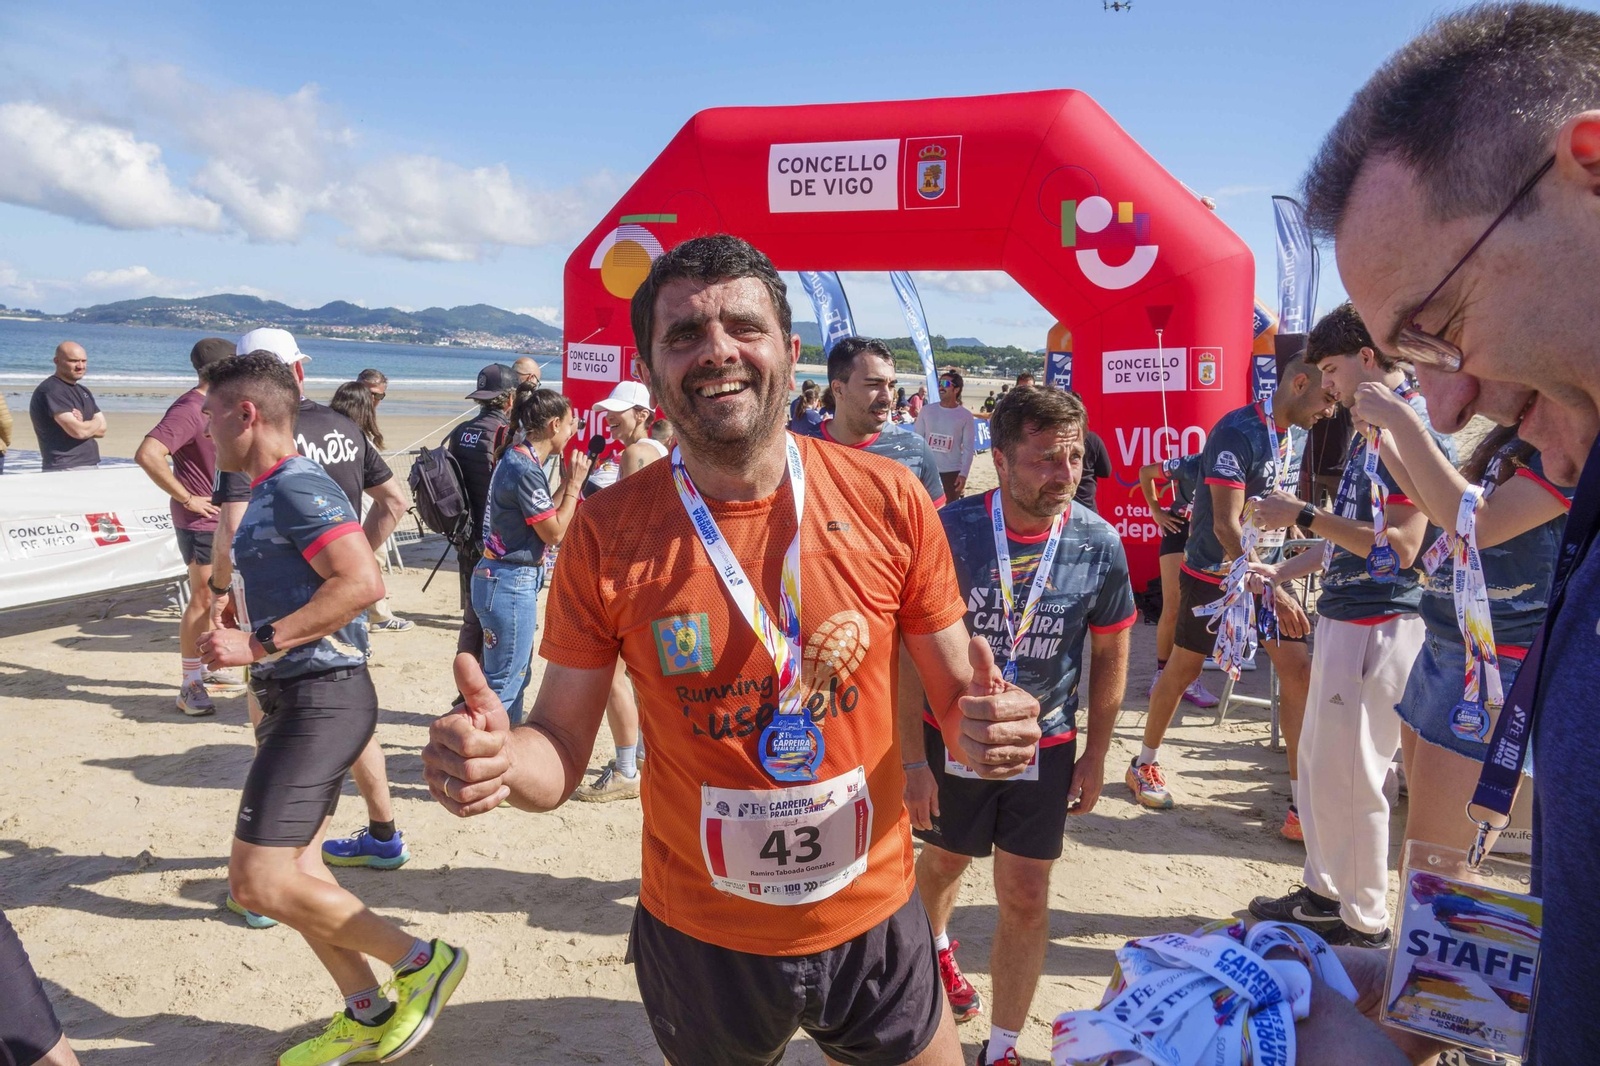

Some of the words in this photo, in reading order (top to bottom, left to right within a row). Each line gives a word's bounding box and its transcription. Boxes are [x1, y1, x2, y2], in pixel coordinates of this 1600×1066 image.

[777, 154, 887, 174] CONCELLO
[790, 179, 816, 196] DE
[823, 177, 873, 195] VIGO
[569, 350, 615, 362] CONCELLO
[1107, 357, 1179, 371] CONCELLO
[572, 362, 582, 371] DE
[585, 363, 608, 373] VIGO
[1115, 372, 1131, 383] DE
[1136, 371, 1170, 382] VIGO
[1115, 426, 1207, 466] VIGO
[1114, 506, 1123, 517] o
[1126, 504, 1152, 517] teu
[8, 522, 79, 539] CONCELLO
[694, 509, 715, 544] CARREIRA
[675, 674, 774, 704] Running
[773, 739, 811, 747] CARREIRA
[1501, 742, 1520, 771] 100
[769, 798, 814, 812] CARREIRA
[770, 810, 793, 819] PRAIA
[803, 805, 825, 815] SAMIL
[759, 826, 822, 867] 43
[775, 867, 804, 876] Taboada
[805, 860, 835, 872] Gonzalez
[783, 883, 801, 892] 100
[1406, 929, 1534, 982] STAFF
[1213, 960, 1248, 988] PRAIA
[1248, 985, 1263, 1001] DE
[1430, 1009, 1470, 1026] CARREIRA
[1275, 1027, 1287, 1041] DE
